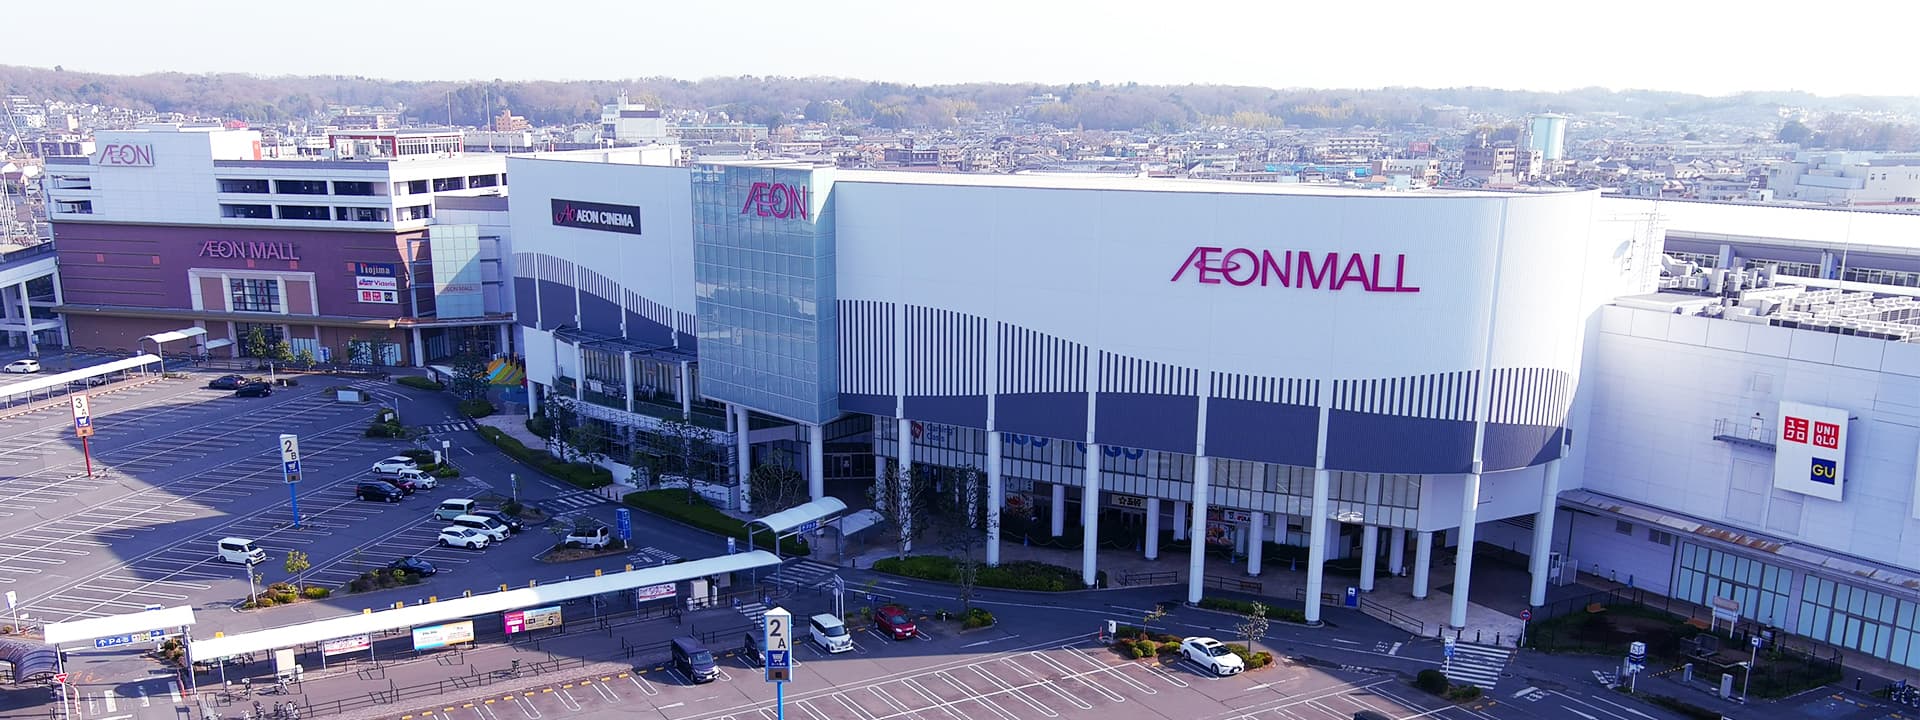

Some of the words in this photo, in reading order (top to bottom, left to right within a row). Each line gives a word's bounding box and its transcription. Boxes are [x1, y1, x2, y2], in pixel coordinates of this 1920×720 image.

[576, 209, 599, 224] AEON
[600, 211, 634, 227] CINEMA
[249, 241, 300, 260] MALL
[75, 398, 82, 408] 3
[284, 440, 293, 453] 2
[291, 452, 297, 460] B
[1812, 464, 1835, 478] GU
[769, 619, 782, 637] 2
[777, 638, 786, 649] A
